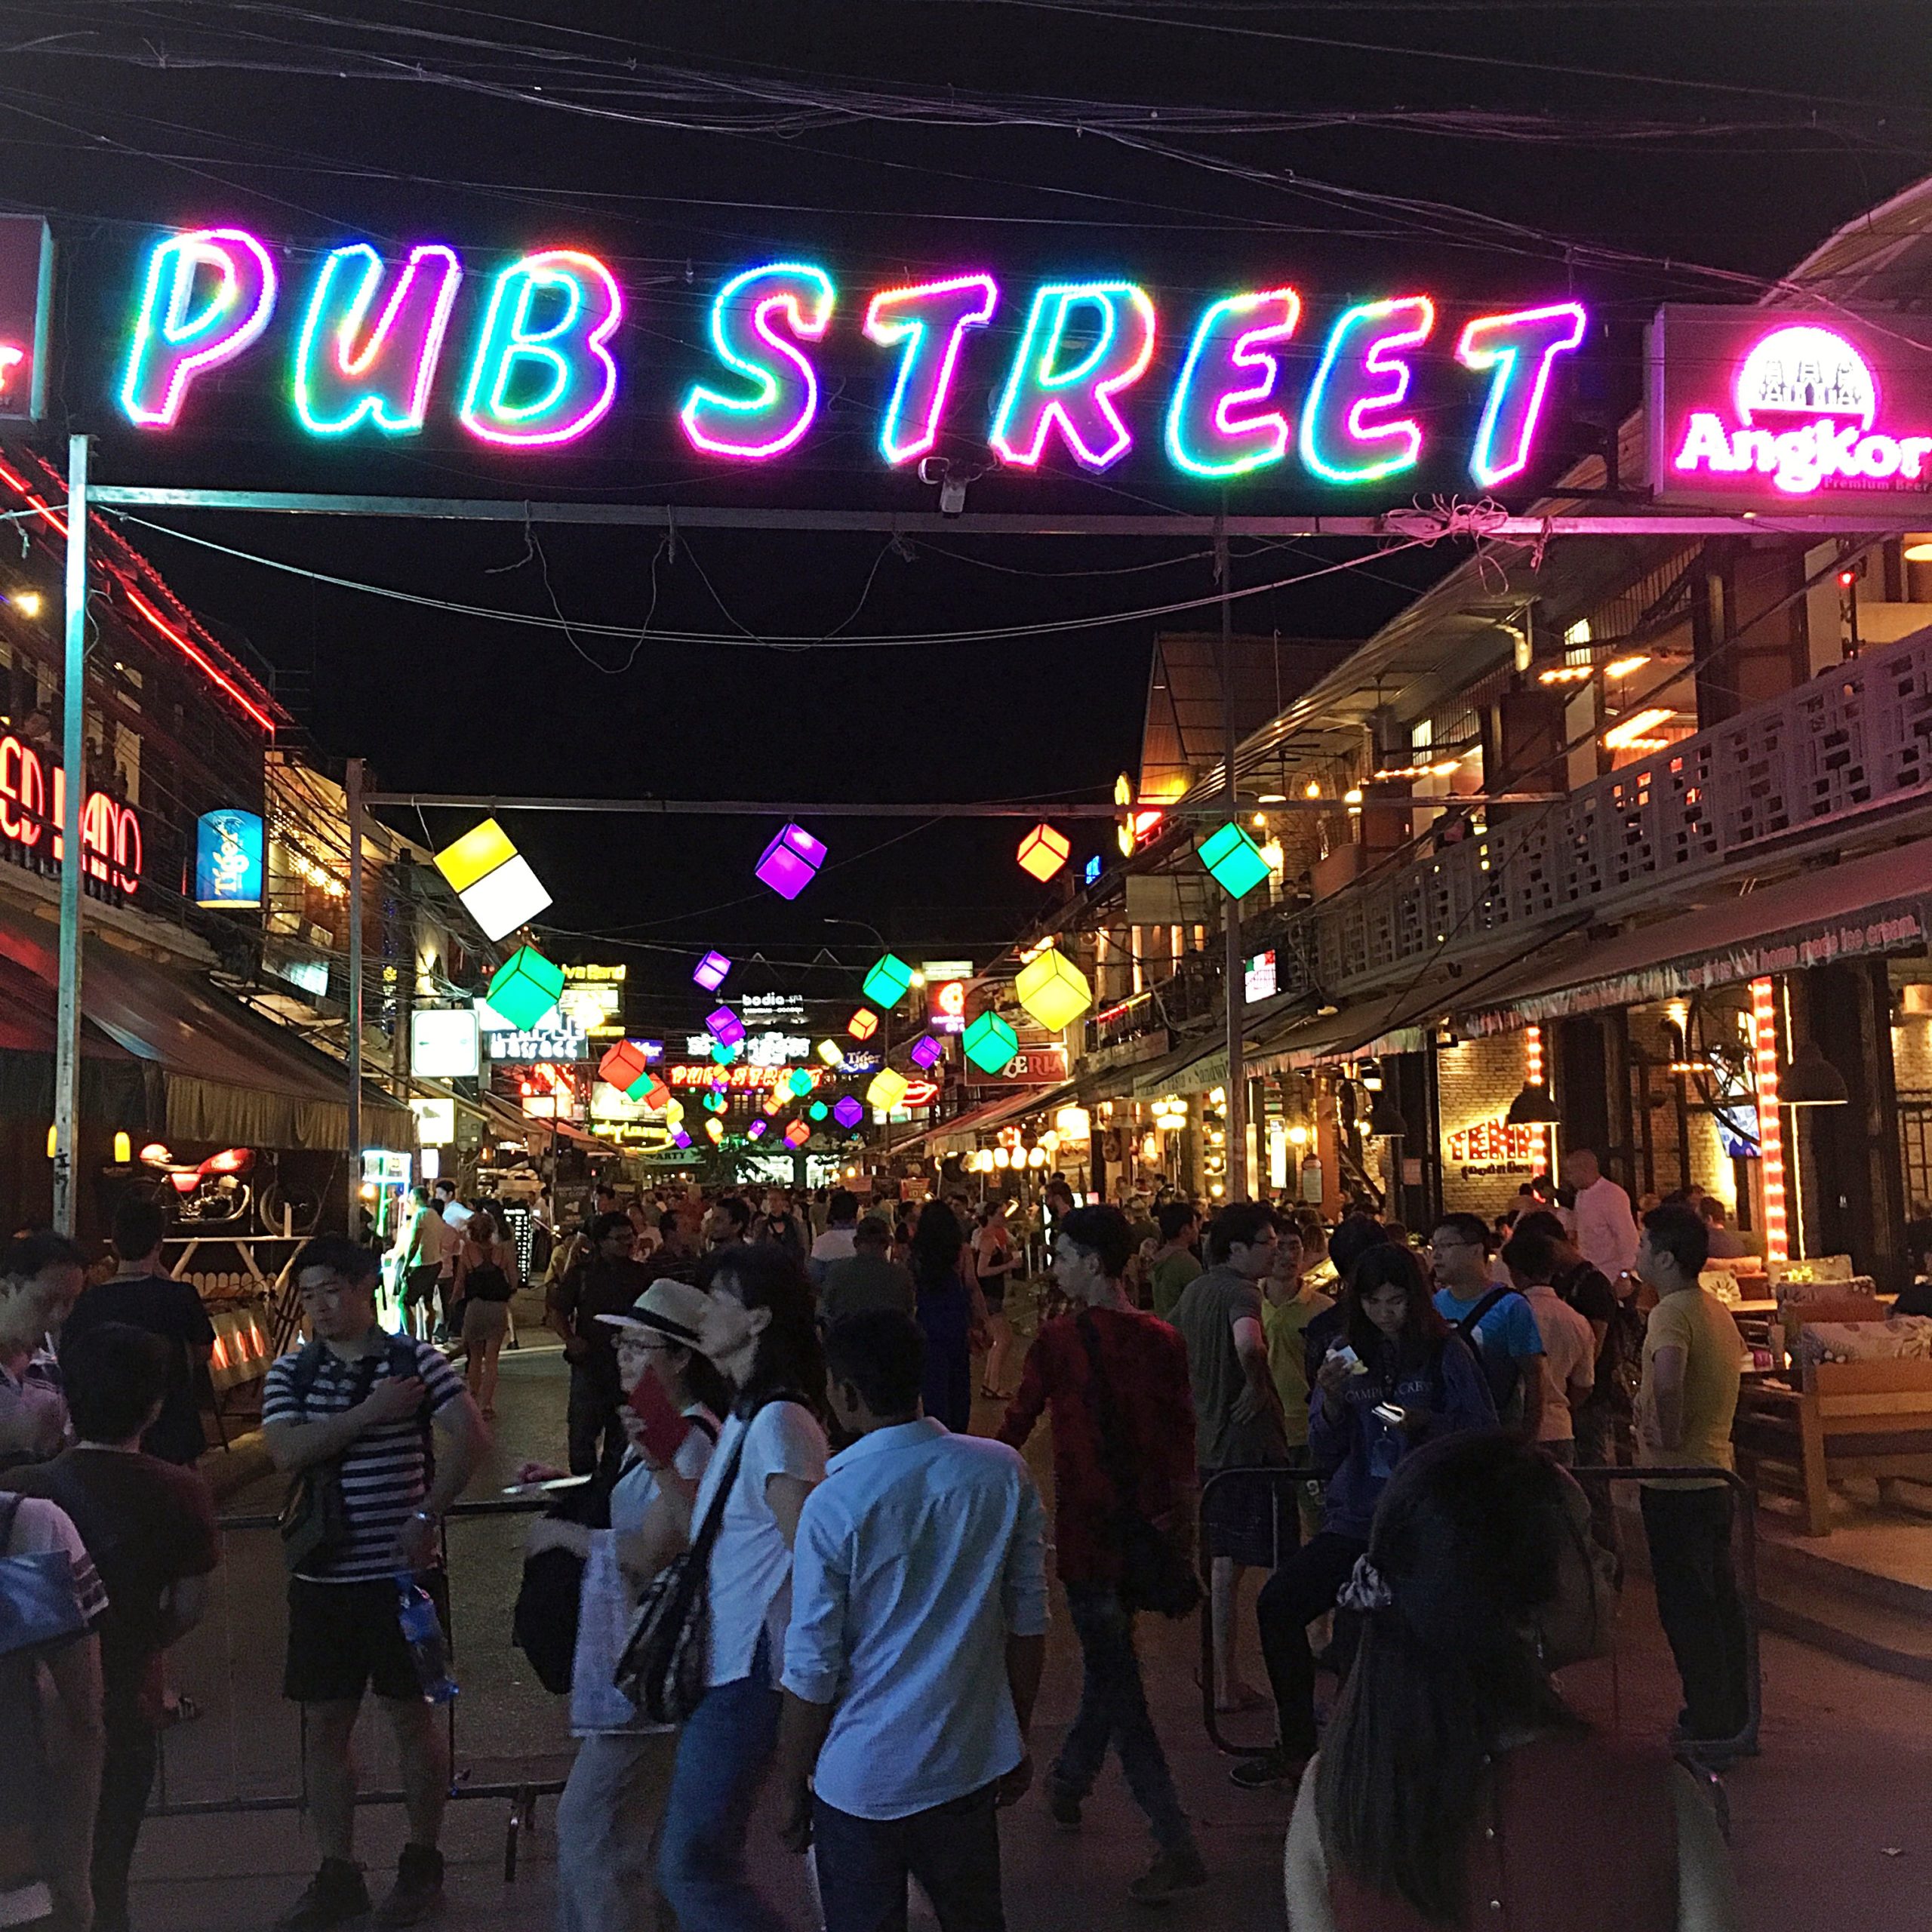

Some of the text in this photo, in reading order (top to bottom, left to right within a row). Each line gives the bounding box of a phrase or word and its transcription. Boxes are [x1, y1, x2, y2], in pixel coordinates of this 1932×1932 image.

[121, 226, 1586, 489] PUB STREET
[1675, 413, 1932, 492] Angkor
[1823, 476, 1890, 491] Premium
[212, 832, 250, 896] Tiger
[1760, 945, 1797, 971] home
[1840, 928, 1864, 952] ice
[743, 992, 784, 1006] bodia
[847, 1051, 881, 1070] Tiger
[731, 1065, 823, 1088] STRET
[1345, 1386, 1395, 1403] CAMPU
